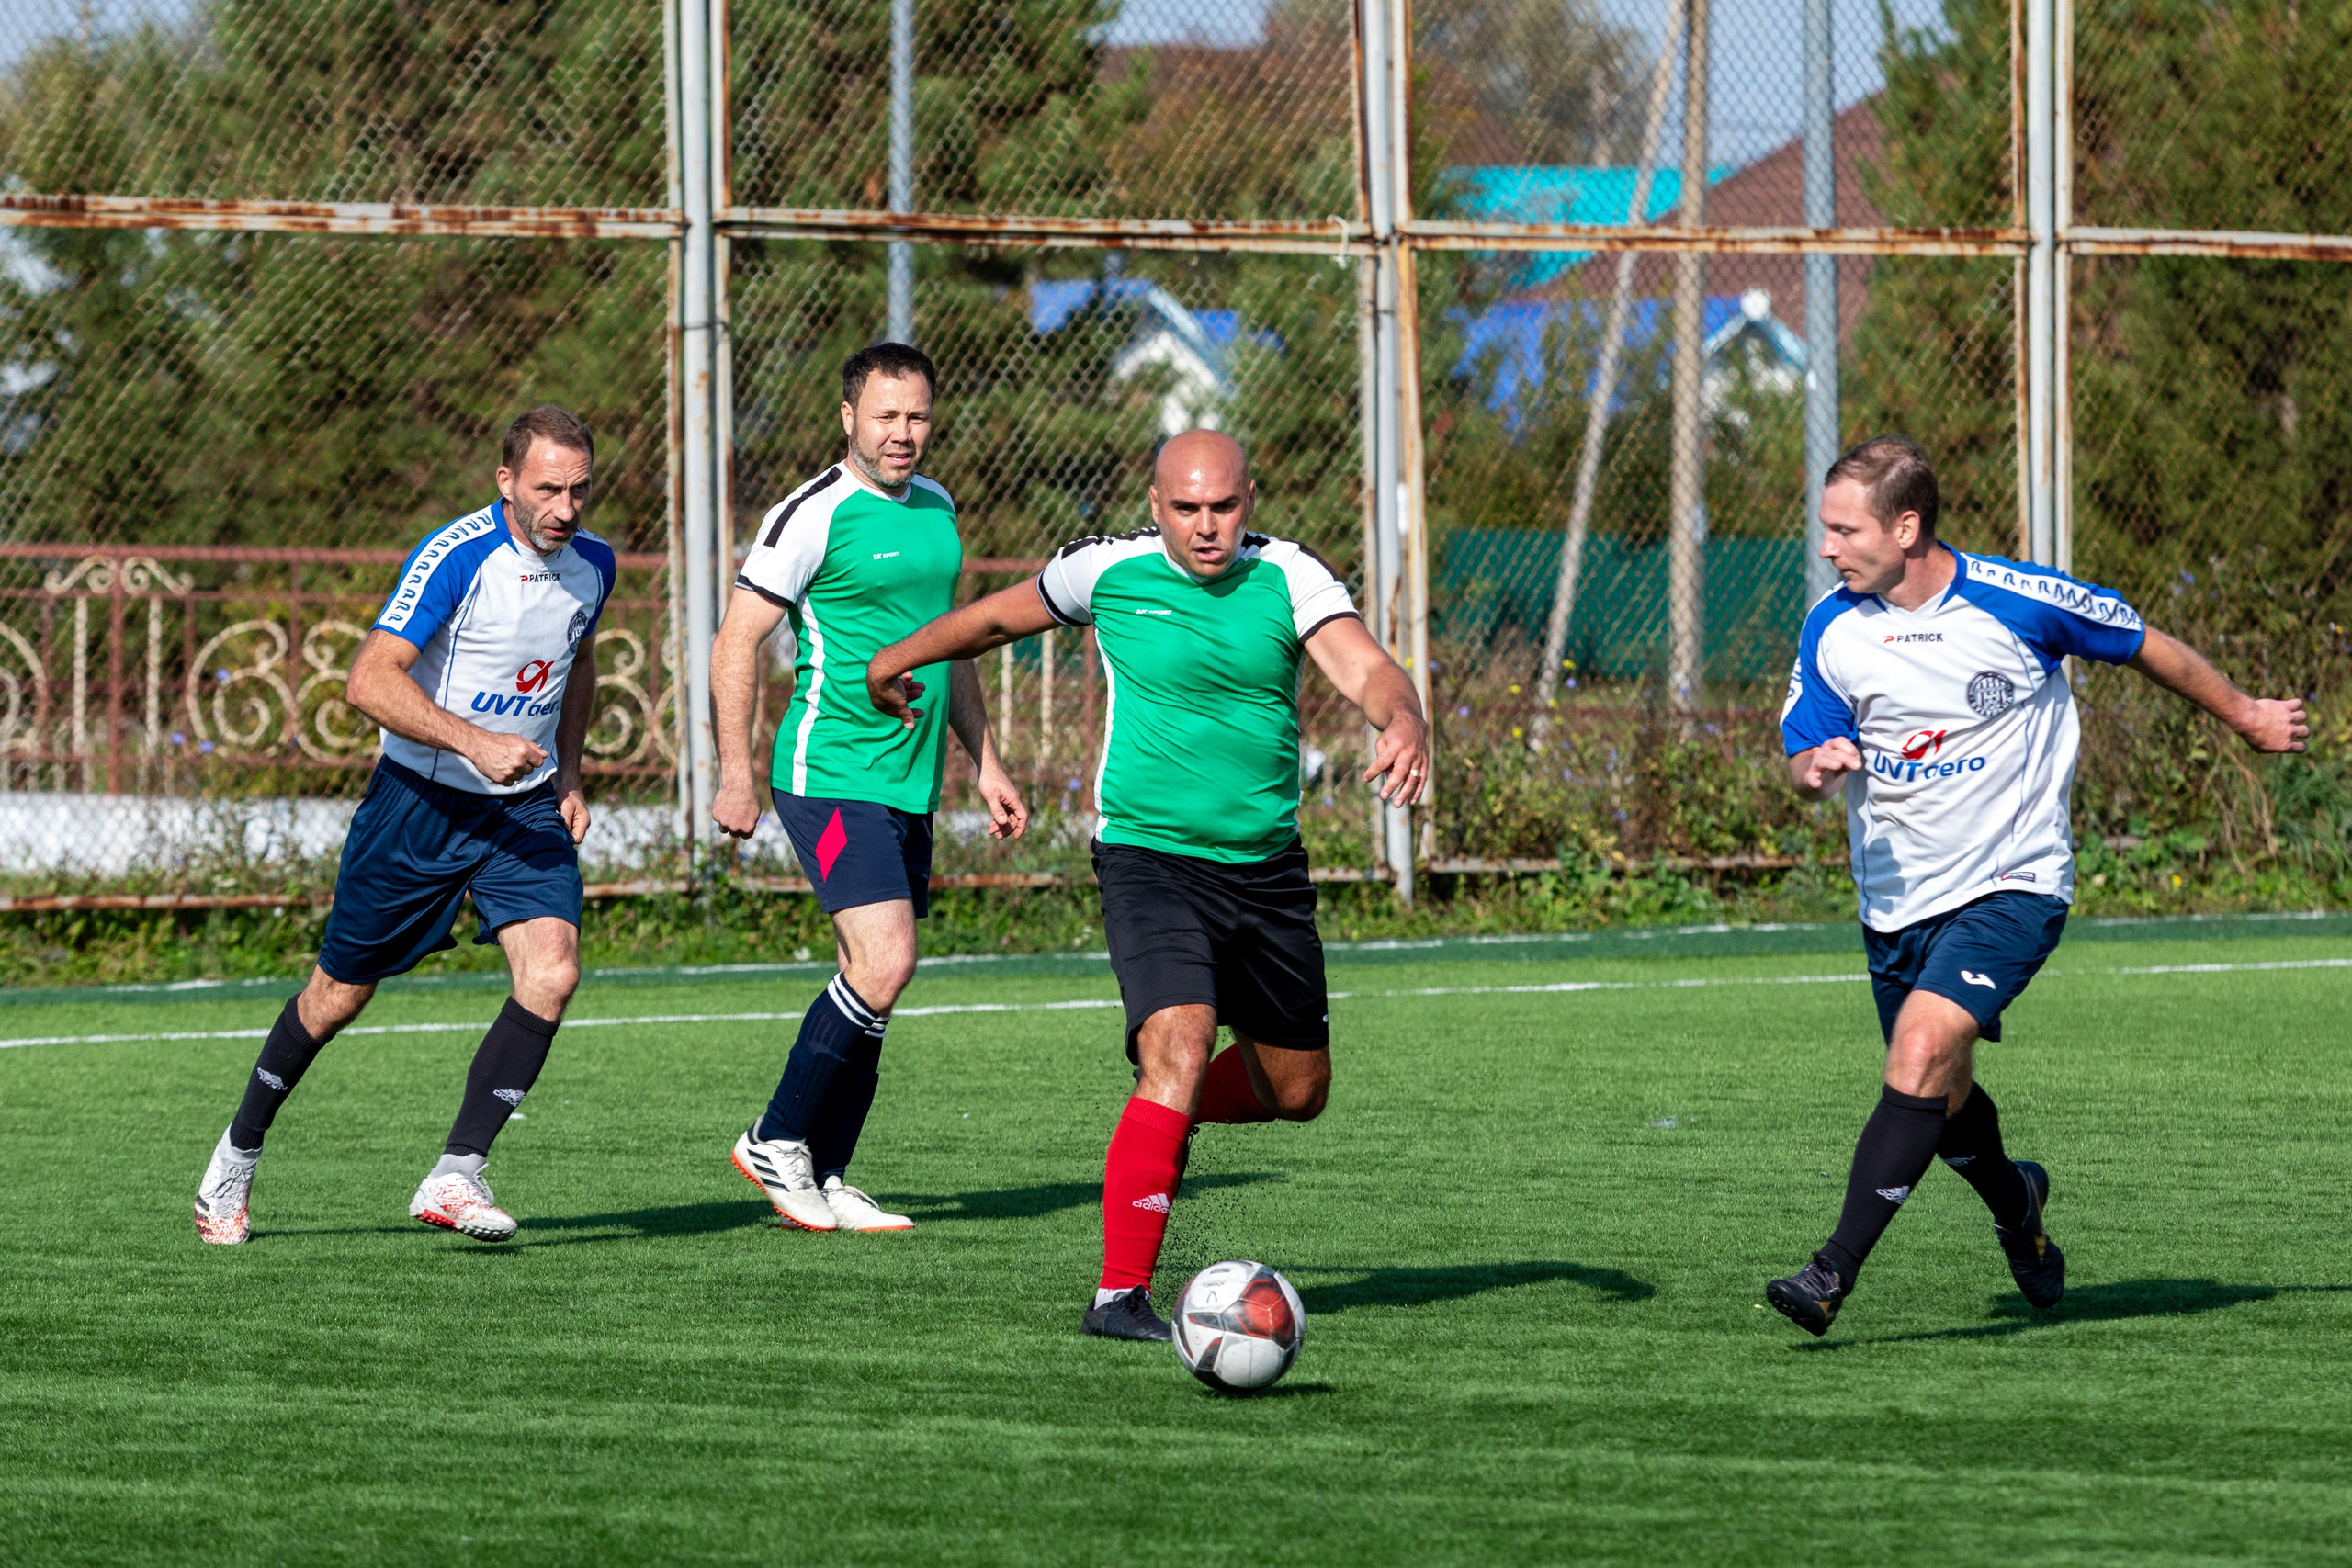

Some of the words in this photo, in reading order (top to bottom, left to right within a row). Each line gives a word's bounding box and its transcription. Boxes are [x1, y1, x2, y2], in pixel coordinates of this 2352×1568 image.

[529, 573, 561, 583] PATRICK
[1896, 633, 1944, 643] PATRICK
[471, 691, 533, 716] UVT
[1874, 750, 1924, 783] UVT
[1923, 756, 1986, 780] aero
